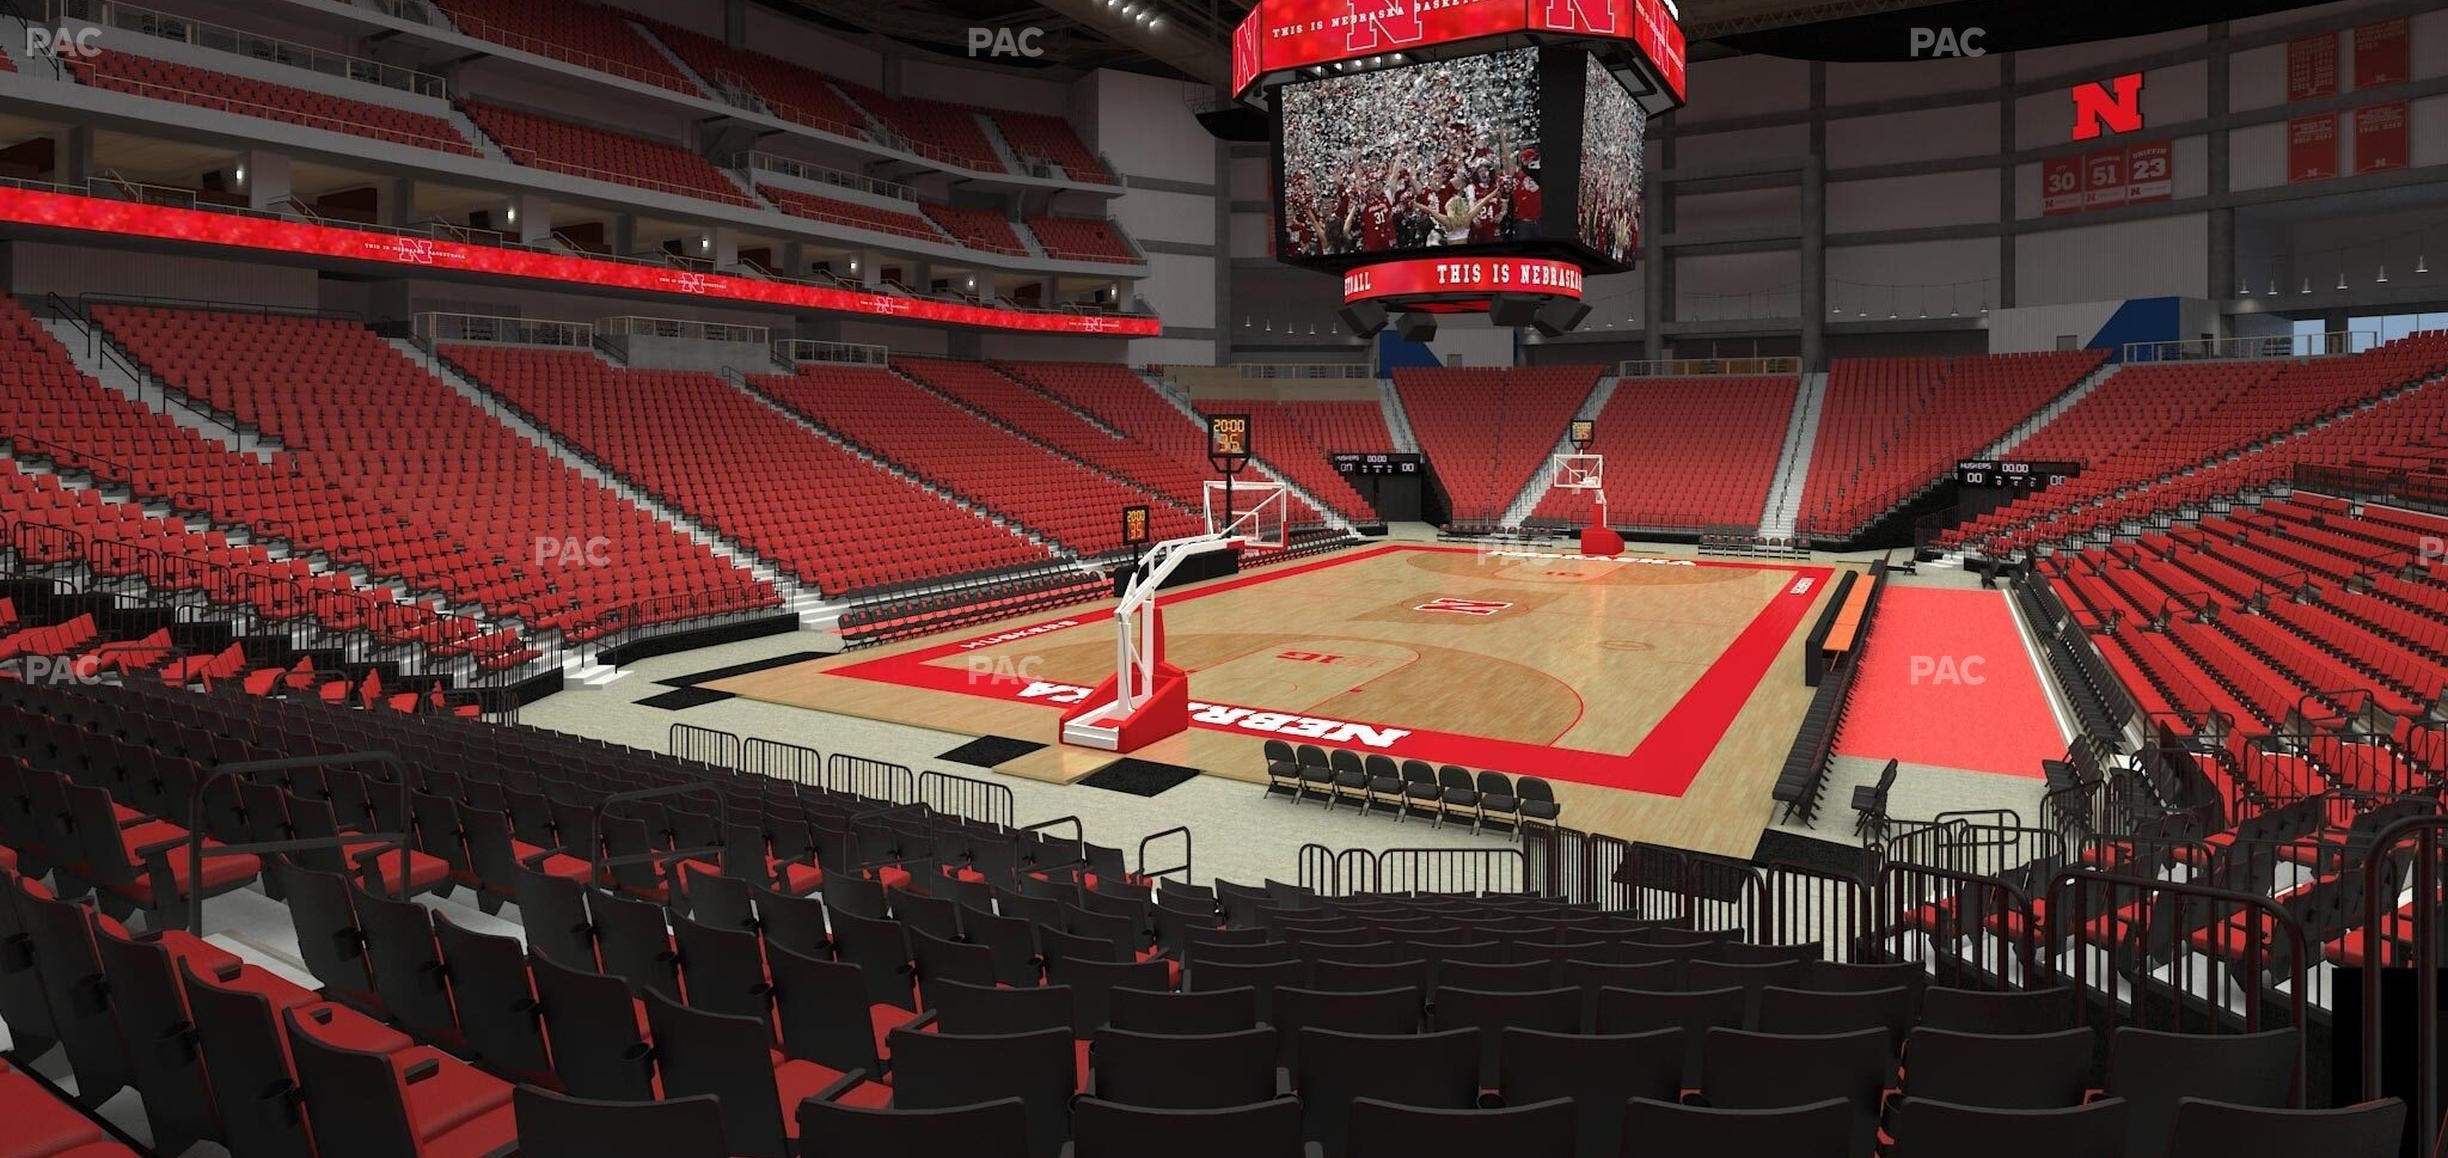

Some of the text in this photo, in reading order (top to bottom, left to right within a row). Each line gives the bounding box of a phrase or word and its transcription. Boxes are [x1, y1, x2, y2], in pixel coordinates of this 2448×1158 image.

[1272, 25, 1303, 38] THIS
[1310, 20, 1324, 31] IS
[1331, 6, 1405, 28] NEBRASKA
[1237, 9, 1258, 94] N
[2071, 72, 2144, 141] N
[2092, 165, 2118, 186] 51
[2133, 157, 2167, 180] 23
[2048, 172, 2076, 193] 30
[399, 238, 433, 264] N
[682, 272, 705, 294] N
[1437, 264, 1579, 290] THIS IS NEBRASKA
[1213, 419, 1245, 433] 20:00
[1401, 463, 1415, 472] 00
[1967, 472, 1983, 483] 00
[2002, 464, 2029, 472] 00:00
[1127, 509, 1146, 522] 20:00
[1413, 598, 1514, 616] N
